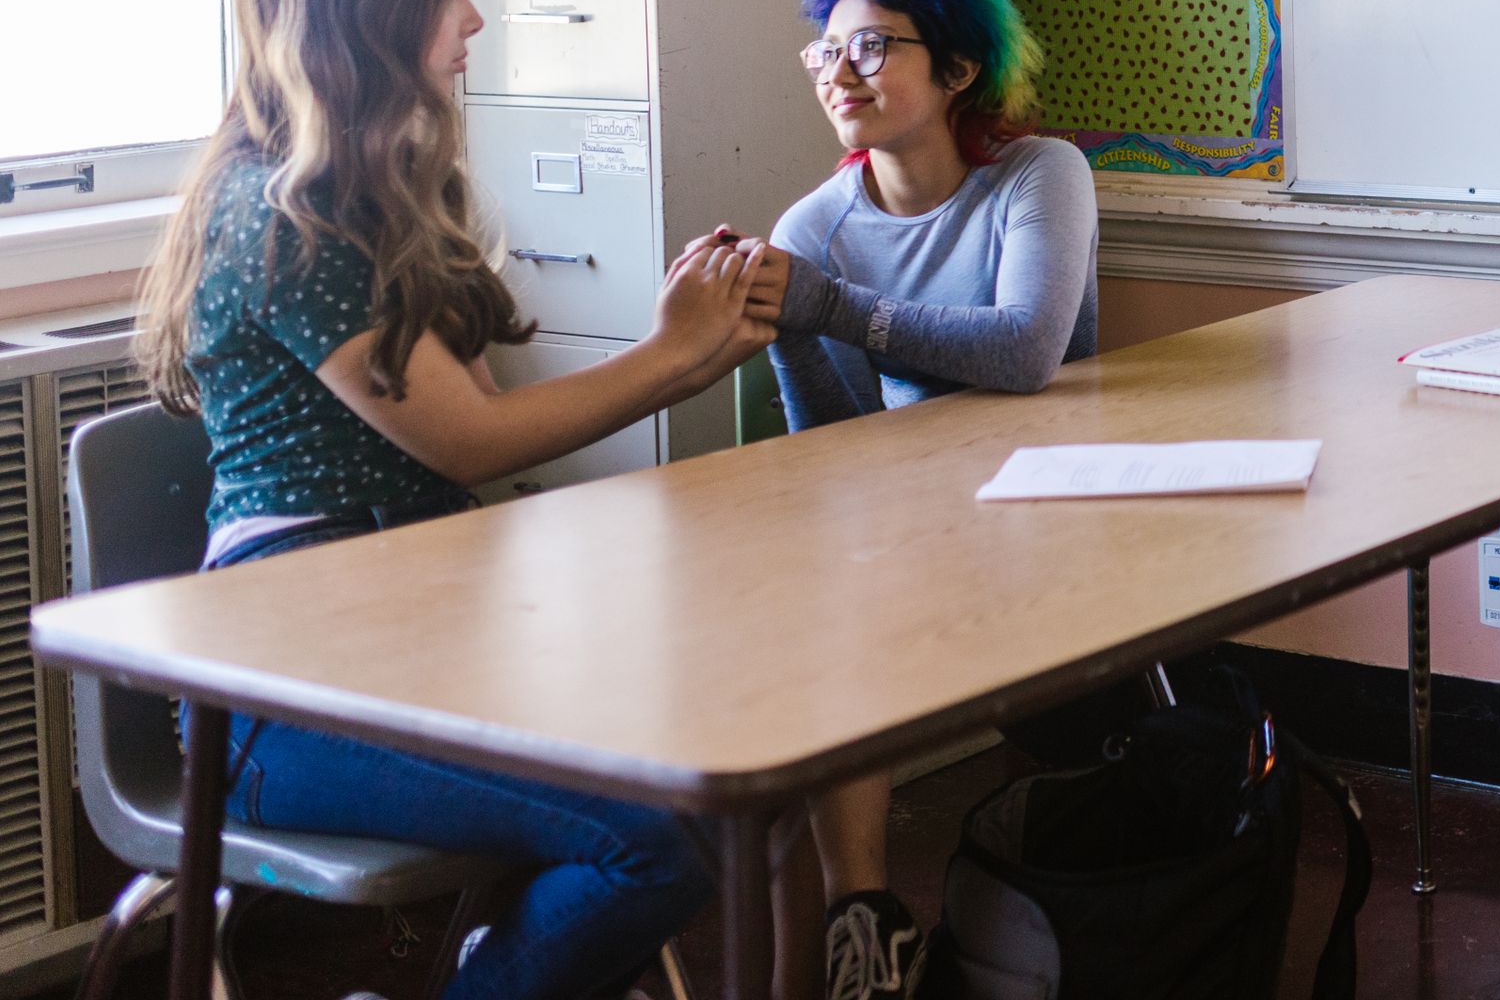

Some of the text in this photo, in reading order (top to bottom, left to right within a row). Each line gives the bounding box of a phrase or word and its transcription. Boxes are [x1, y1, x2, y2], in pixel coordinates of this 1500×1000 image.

[590, 117, 635, 137] Handouts
[1171, 135, 1257, 160] RESPONSIBILITY
[1096, 149, 1172, 172] CITIZENSHIP
